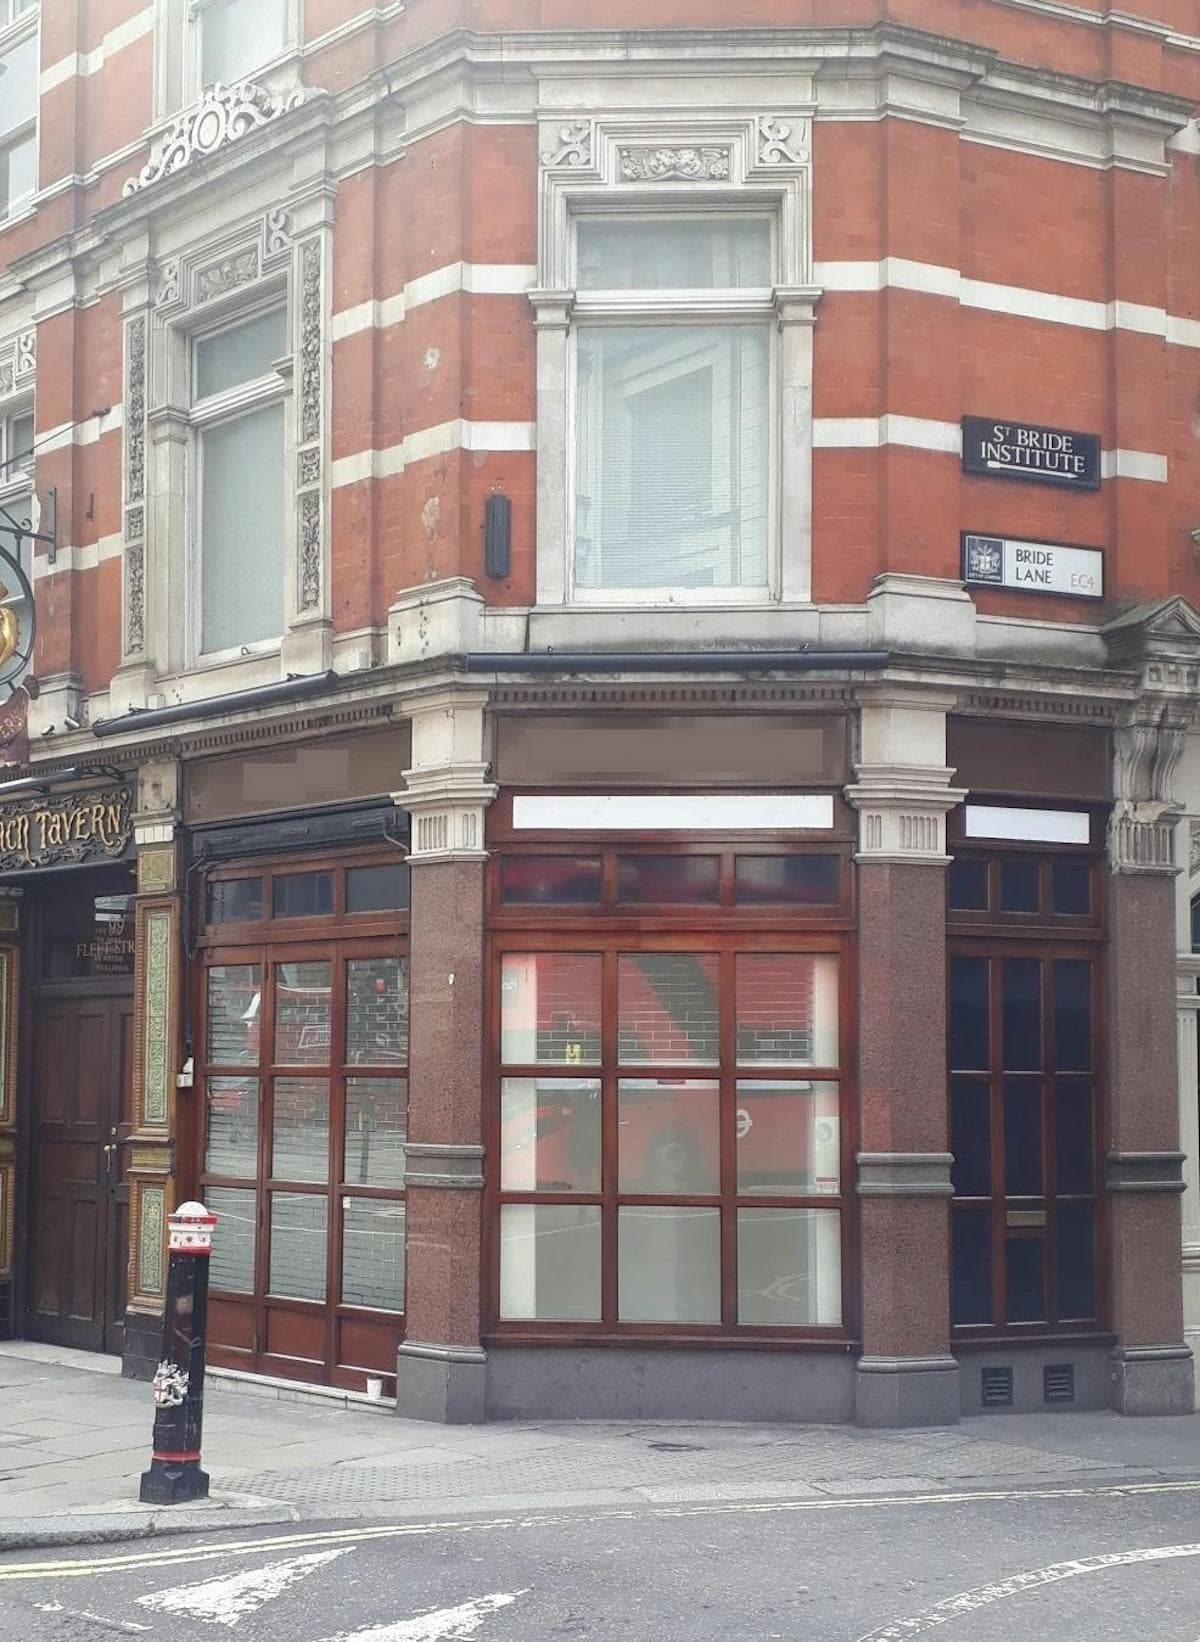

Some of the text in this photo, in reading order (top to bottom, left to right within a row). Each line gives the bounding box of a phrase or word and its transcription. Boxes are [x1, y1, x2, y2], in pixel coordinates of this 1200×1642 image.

[1017, 429, 1073, 453] BRIDE
[981, 441, 1086, 473] INSTITUTE
[1015, 549, 1054, 566] BRIDE
[1015, 567, 1052, 584] LANE
[1070, 573, 1095, 589] EC4
